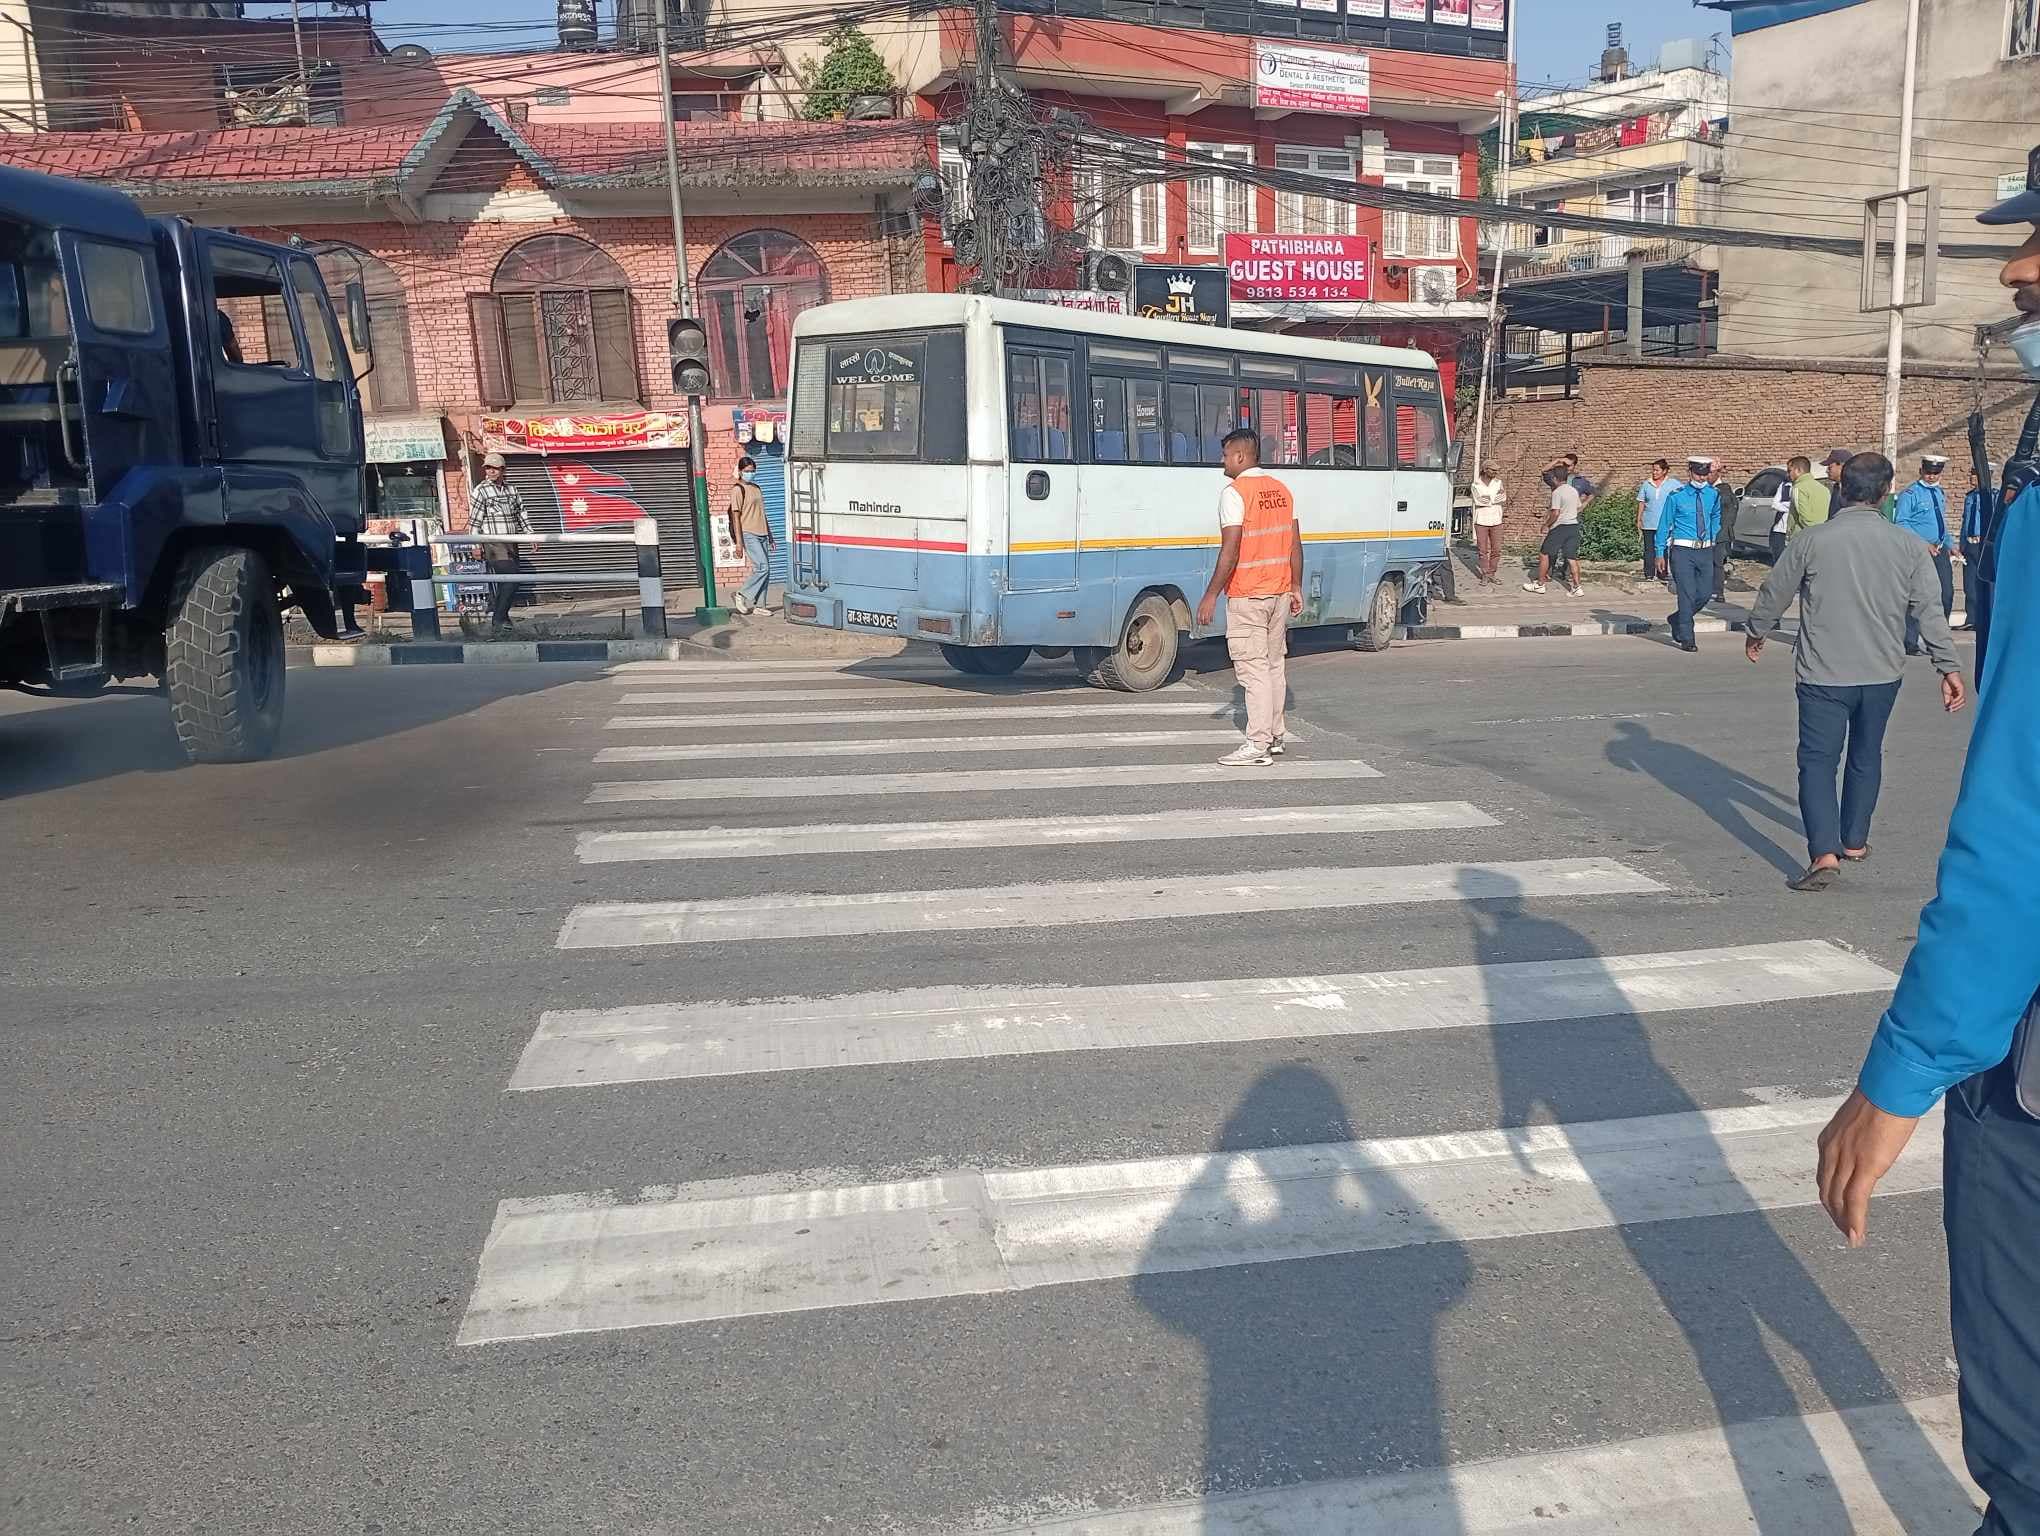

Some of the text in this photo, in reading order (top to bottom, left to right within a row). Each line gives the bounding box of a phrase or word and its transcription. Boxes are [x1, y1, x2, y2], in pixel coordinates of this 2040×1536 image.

[1280, 70, 1303, 80] DENTAL
[1313, 73, 1346, 83] AESTHETIC
[1350, 76, 1367, 86] CARE
[1251, 239, 1345, 256] PATHIBHARA
[1230, 260, 1365, 281] GUEST HOUSE
[1246, 286, 1349, 298] 9813 534 134
[1166, 295, 1195, 312] JH
[836, 373, 915, 384] WEL COME
[1259, 490, 1281, 499] TRAFFIC
[849, 500, 901, 513] Mahindra
[1259, 498, 1287, 510] POLICE
